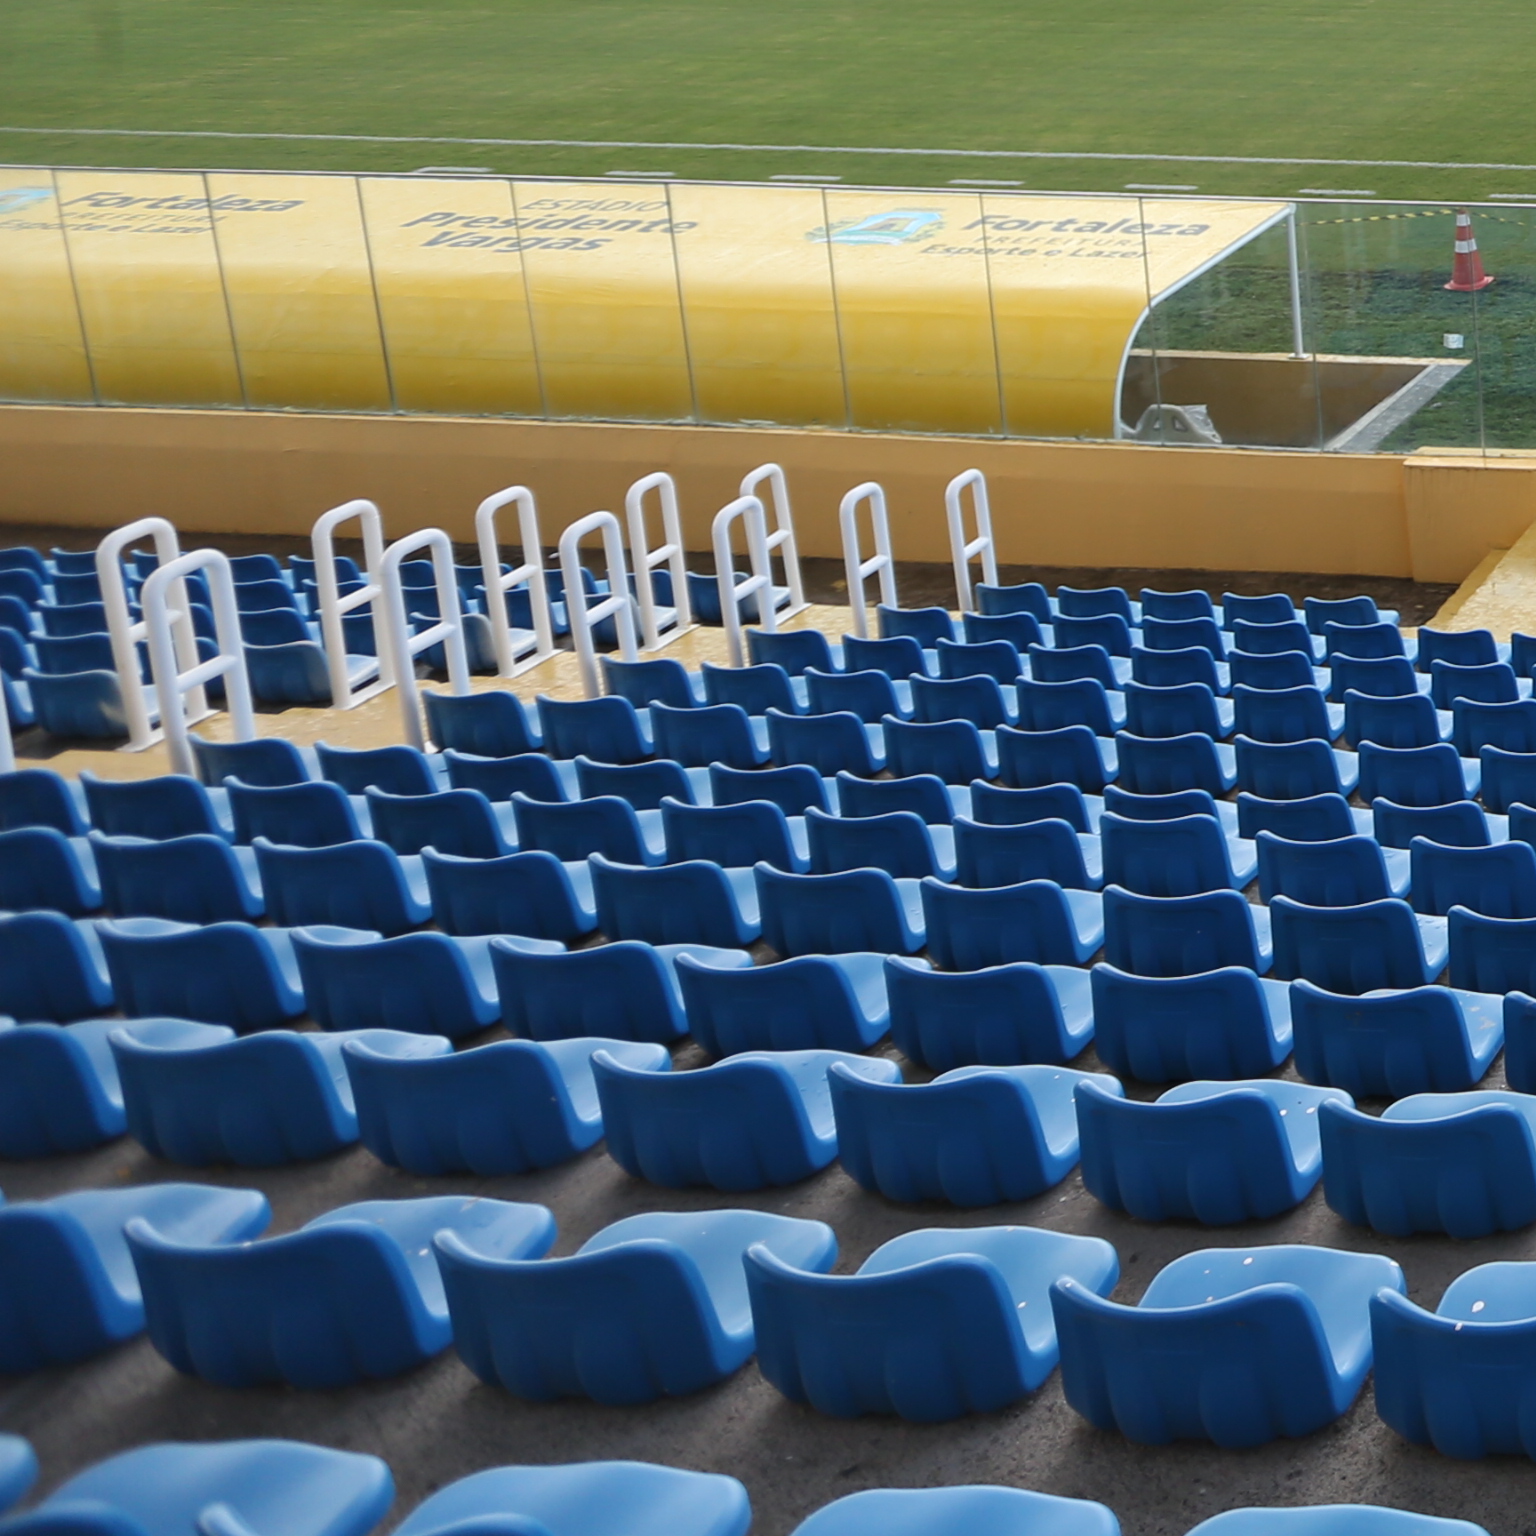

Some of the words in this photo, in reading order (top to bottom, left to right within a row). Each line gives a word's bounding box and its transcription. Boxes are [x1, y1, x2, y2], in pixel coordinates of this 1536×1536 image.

[62, 191, 305, 212] Fortaleza
[401, 211, 699, 234] Presidente
[961, 214, 1211, 236] Fortaleza
[421, 231, 613, 253] Vargas
[921, 244, 1037, 260] Esporte
[1042, 247, 1063, 258] e
[1069, 246, 1152, 260] Lazer
